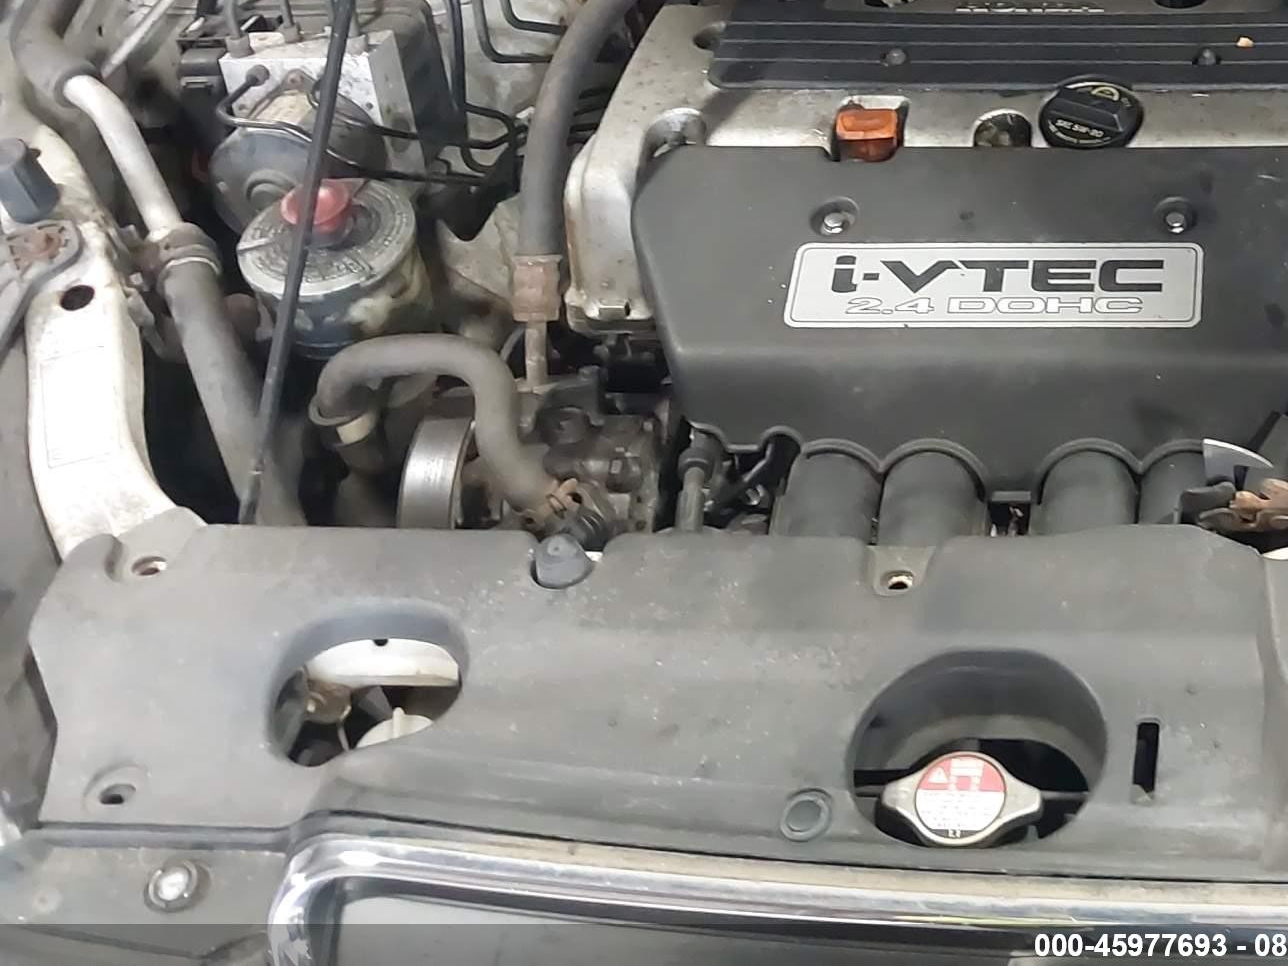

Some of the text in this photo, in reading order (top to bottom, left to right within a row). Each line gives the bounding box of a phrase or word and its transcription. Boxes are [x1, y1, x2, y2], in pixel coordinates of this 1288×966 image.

[830, 254, 1165, 294] i-VTEC
[845, 296, 1144, 315] 2.4 DOHC
